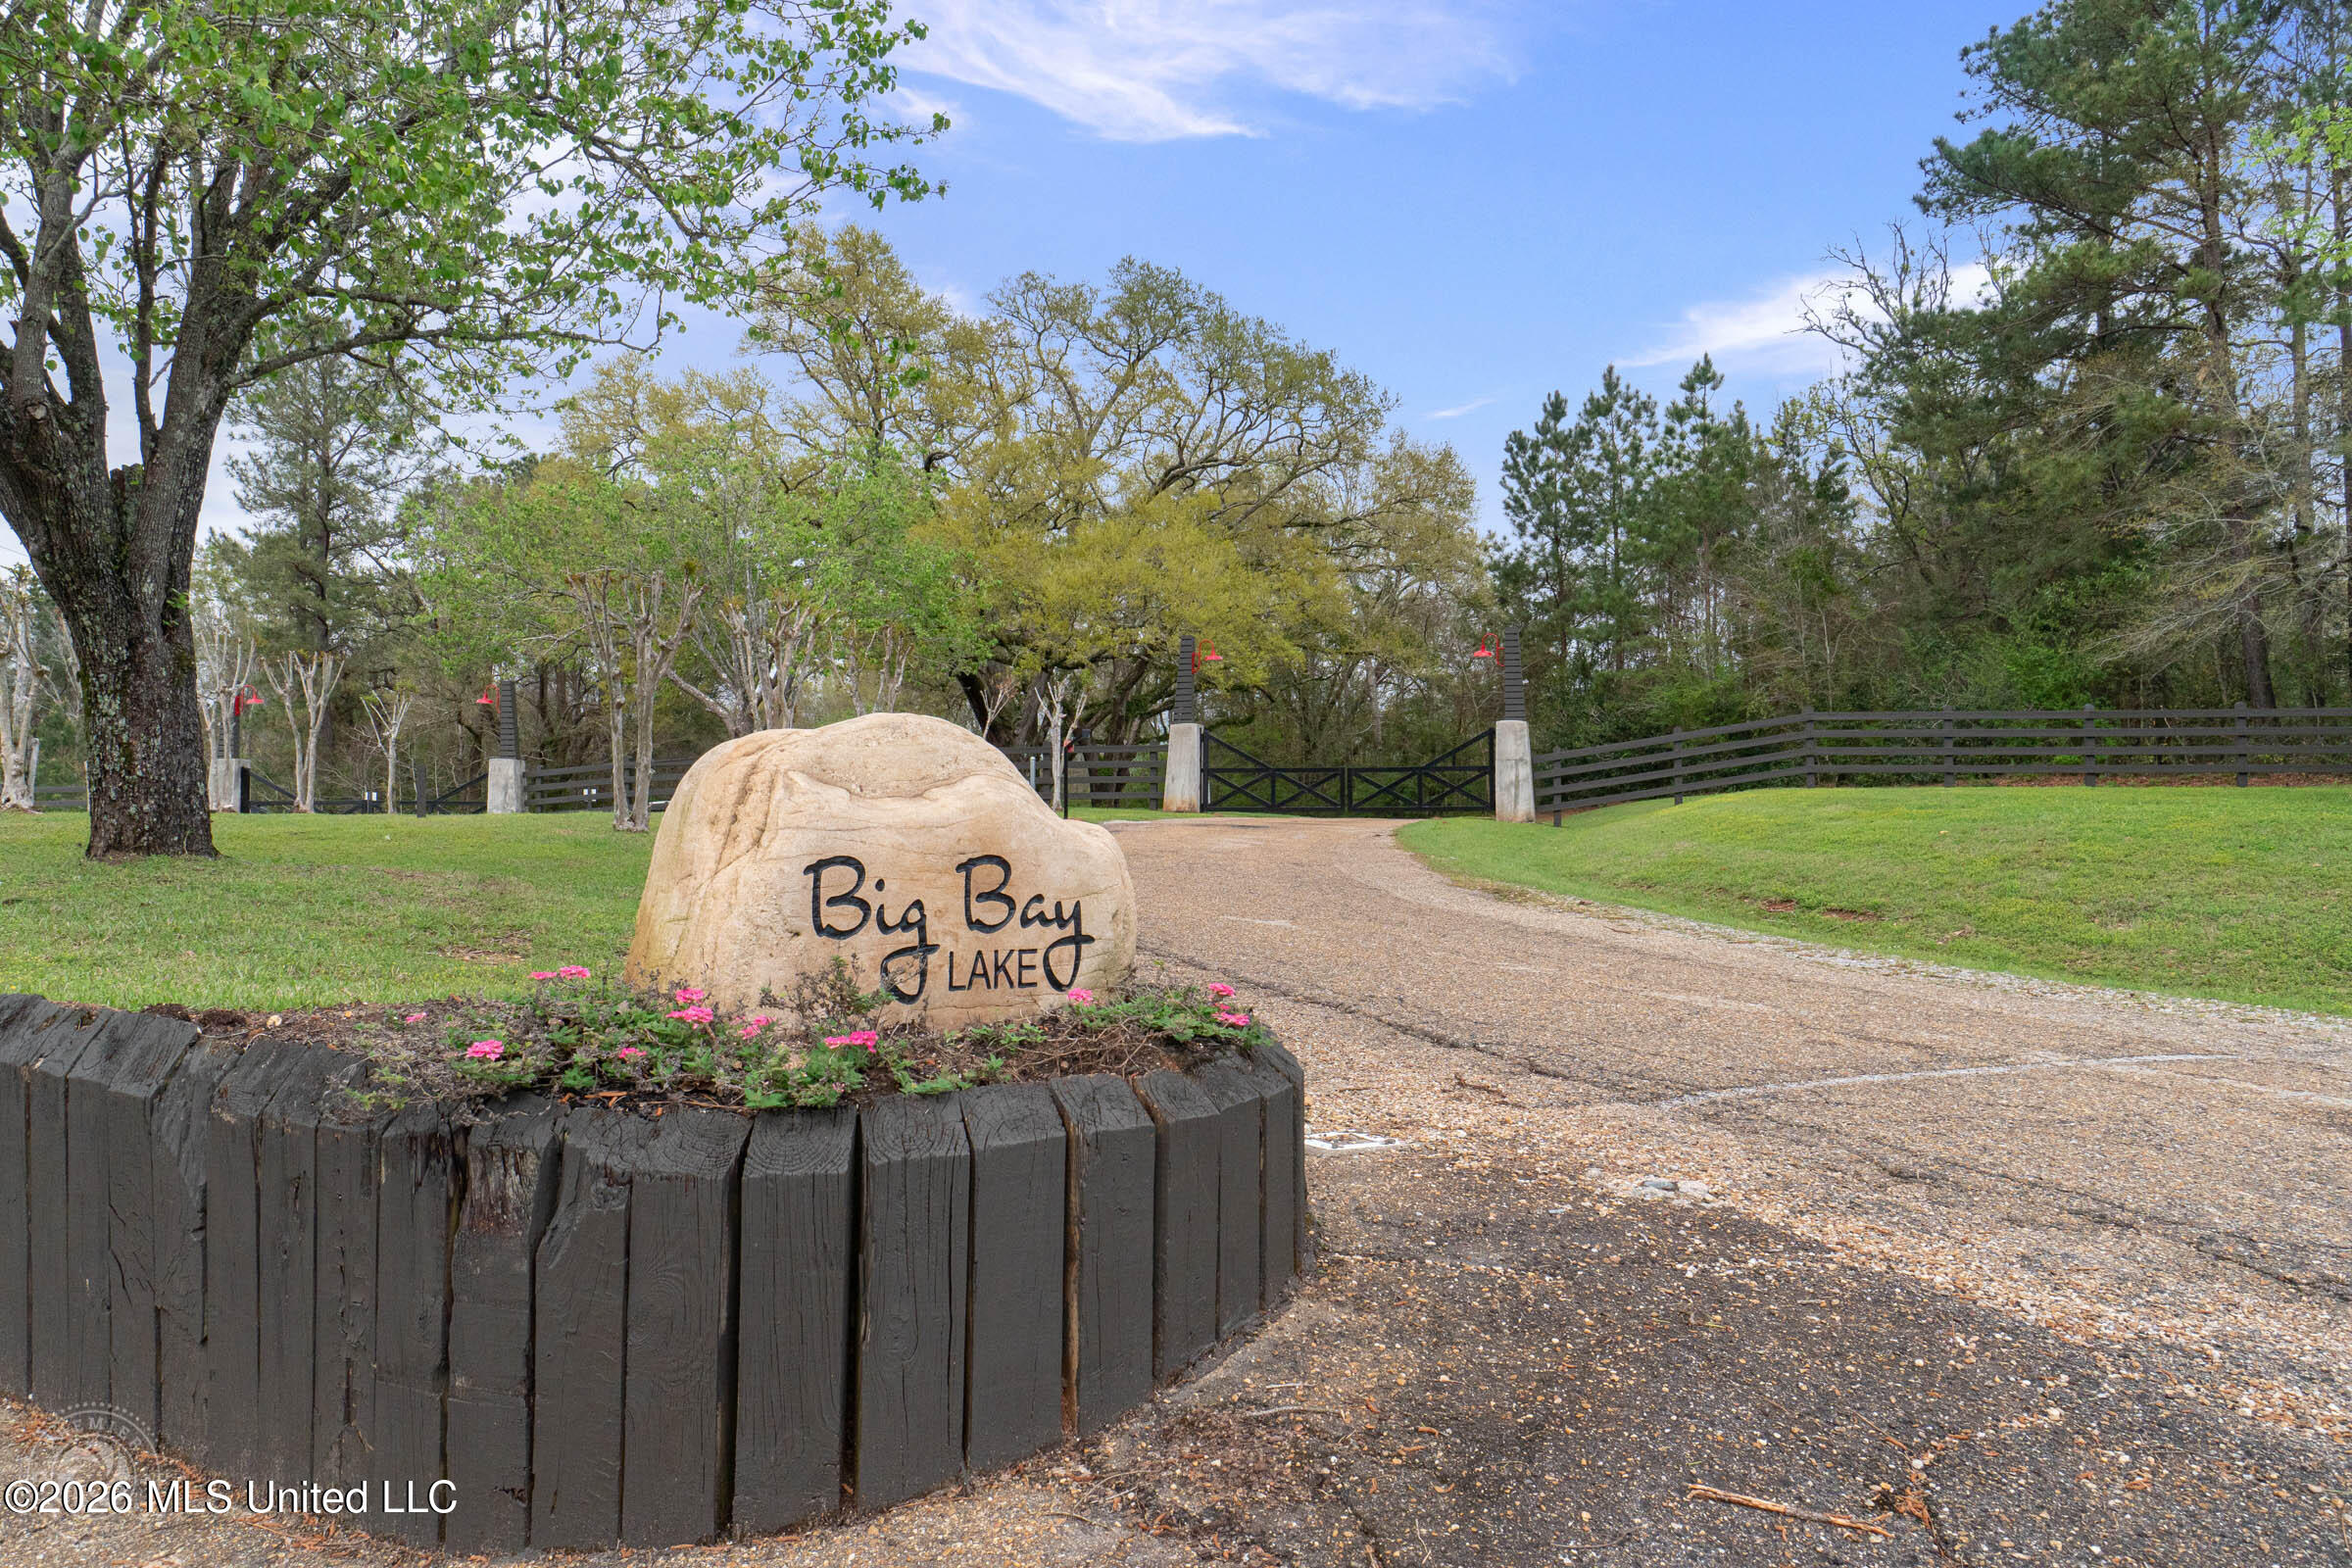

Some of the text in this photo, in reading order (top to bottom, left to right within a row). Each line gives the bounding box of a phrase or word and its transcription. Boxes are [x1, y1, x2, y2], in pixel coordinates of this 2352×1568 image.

[803, 855, 1096, 1005] Big Bay
[948, 949, 1038, 992] LAKE
